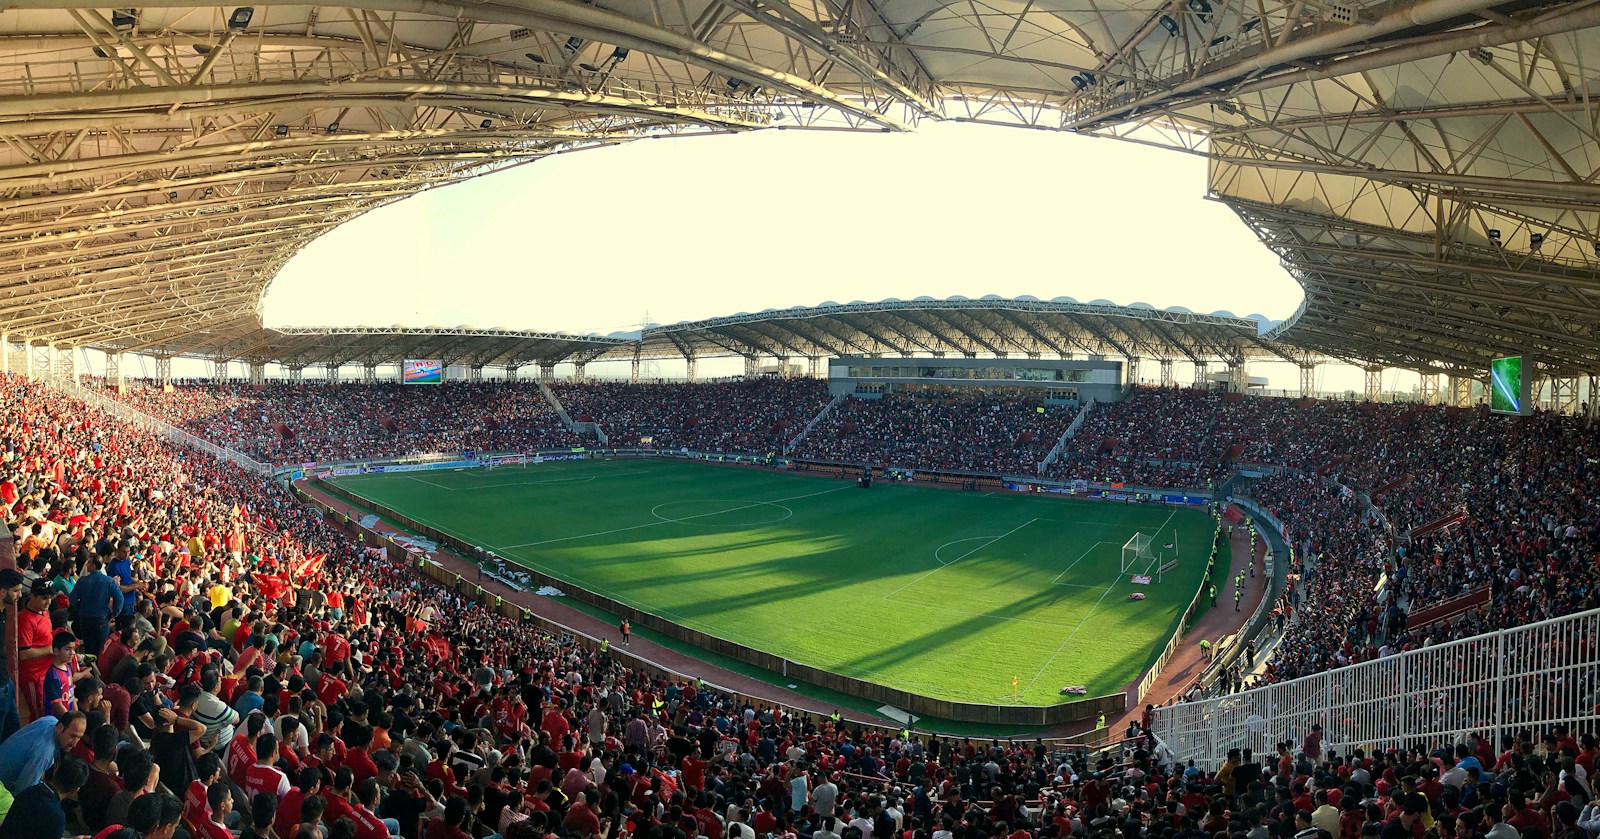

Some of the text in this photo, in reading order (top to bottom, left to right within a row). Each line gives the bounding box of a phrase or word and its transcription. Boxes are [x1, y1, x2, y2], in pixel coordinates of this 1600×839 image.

[334, 639, 341, 651] 7
[321, 681, 329, 693] 7
[230, 754, 239, 775] 9
